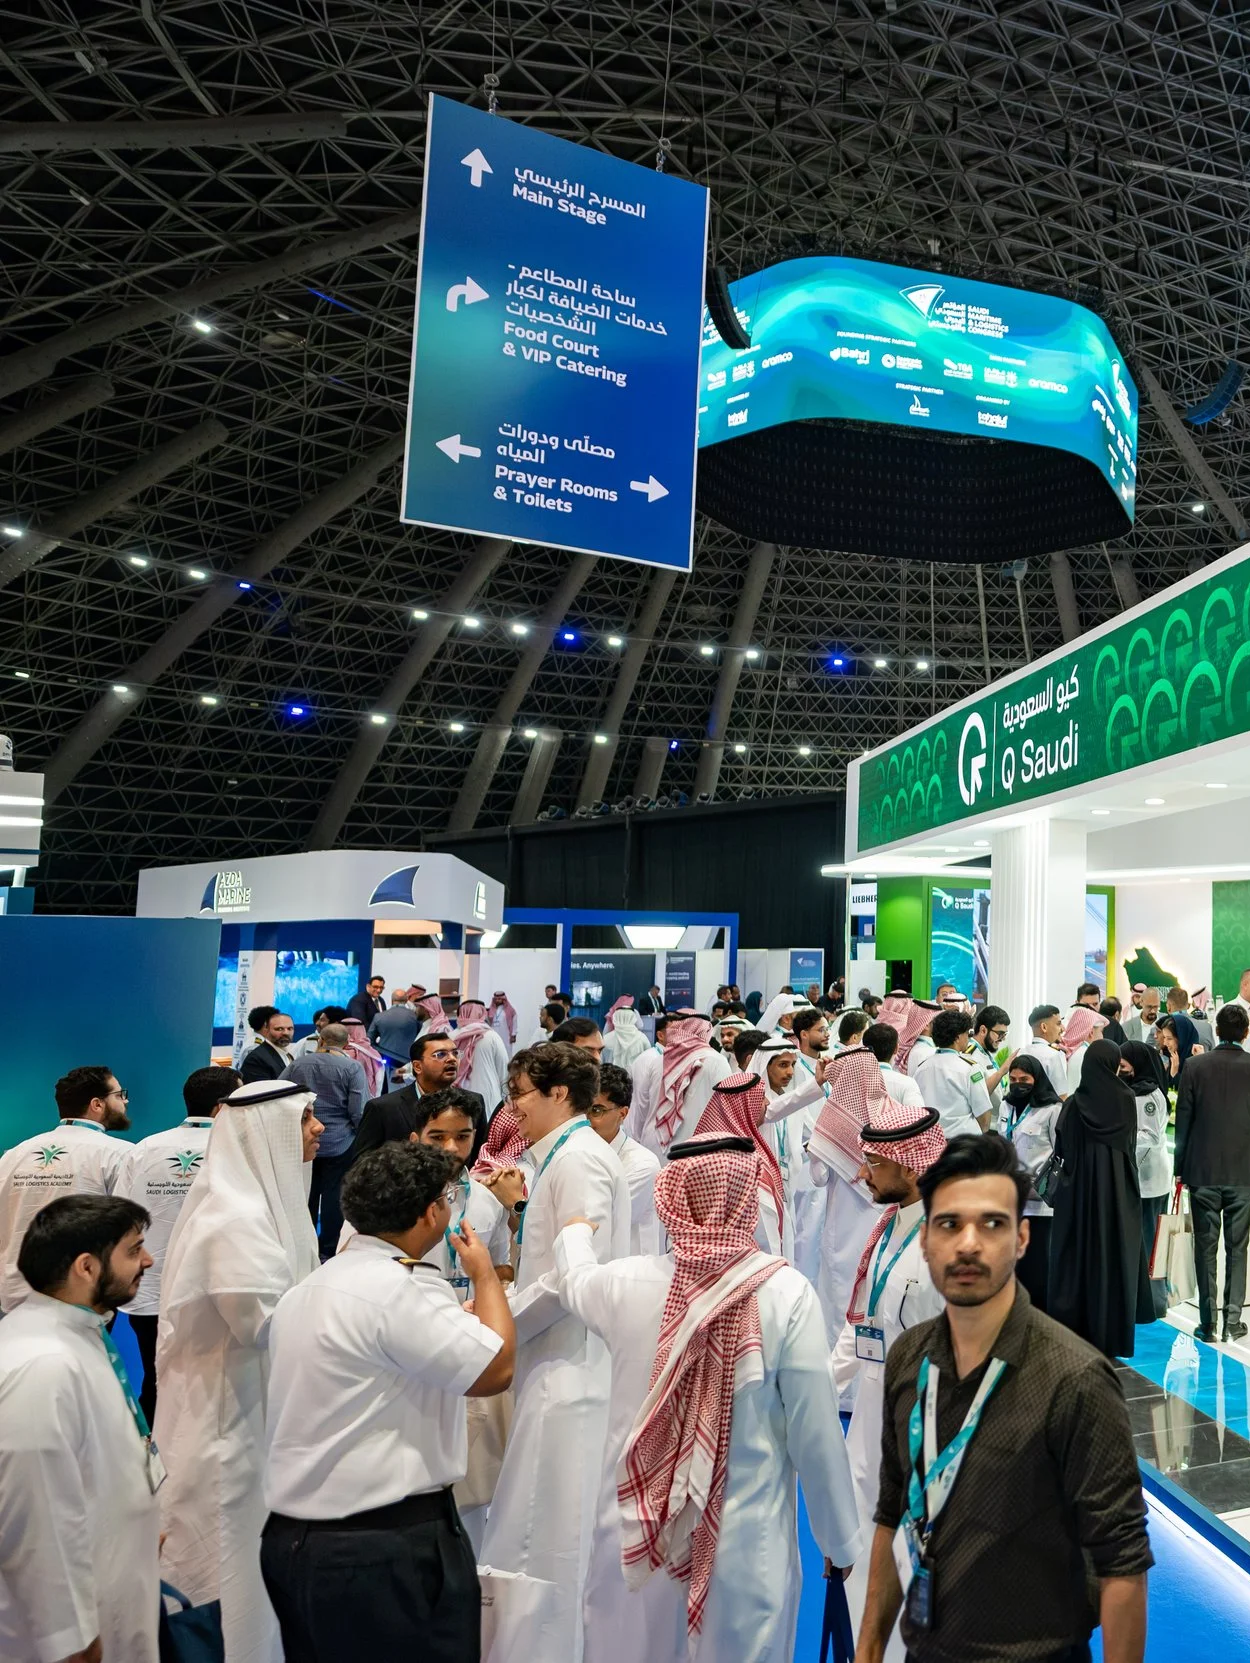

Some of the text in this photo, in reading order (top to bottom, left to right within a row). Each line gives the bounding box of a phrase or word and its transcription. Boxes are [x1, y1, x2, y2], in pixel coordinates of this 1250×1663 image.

[512, 184, 607, 225] Main Stage
[514, 167, 646, 218] المسرح الرئيسي
[519, 266, 587, 293] المطاعم
[591, 283, 636, 308] ساحة
[506, 280, 668, 336] خدمات الضيافة لكبار
[506, 301, 596, 336] الشخصيات
[504, 321, 599, 358] Food Court
[502, 342, 627, 387] & VIP Catering
[1028, 378, 1068, 393] aramco
[496, 442, 545, 464] المياه
[498, 422, 559, 450] ودورات
[494, 486, 573, 513] & Toilets
[495, 464, 618, 502] Prayer Rooms
[1003, 664, 1079, 733] كيو السعودية
[1001, 719, 1079, 795] Q Saudi
[218, 888, 251, 905] MARINE
[852, 895, 877, 903] LIEBHER
